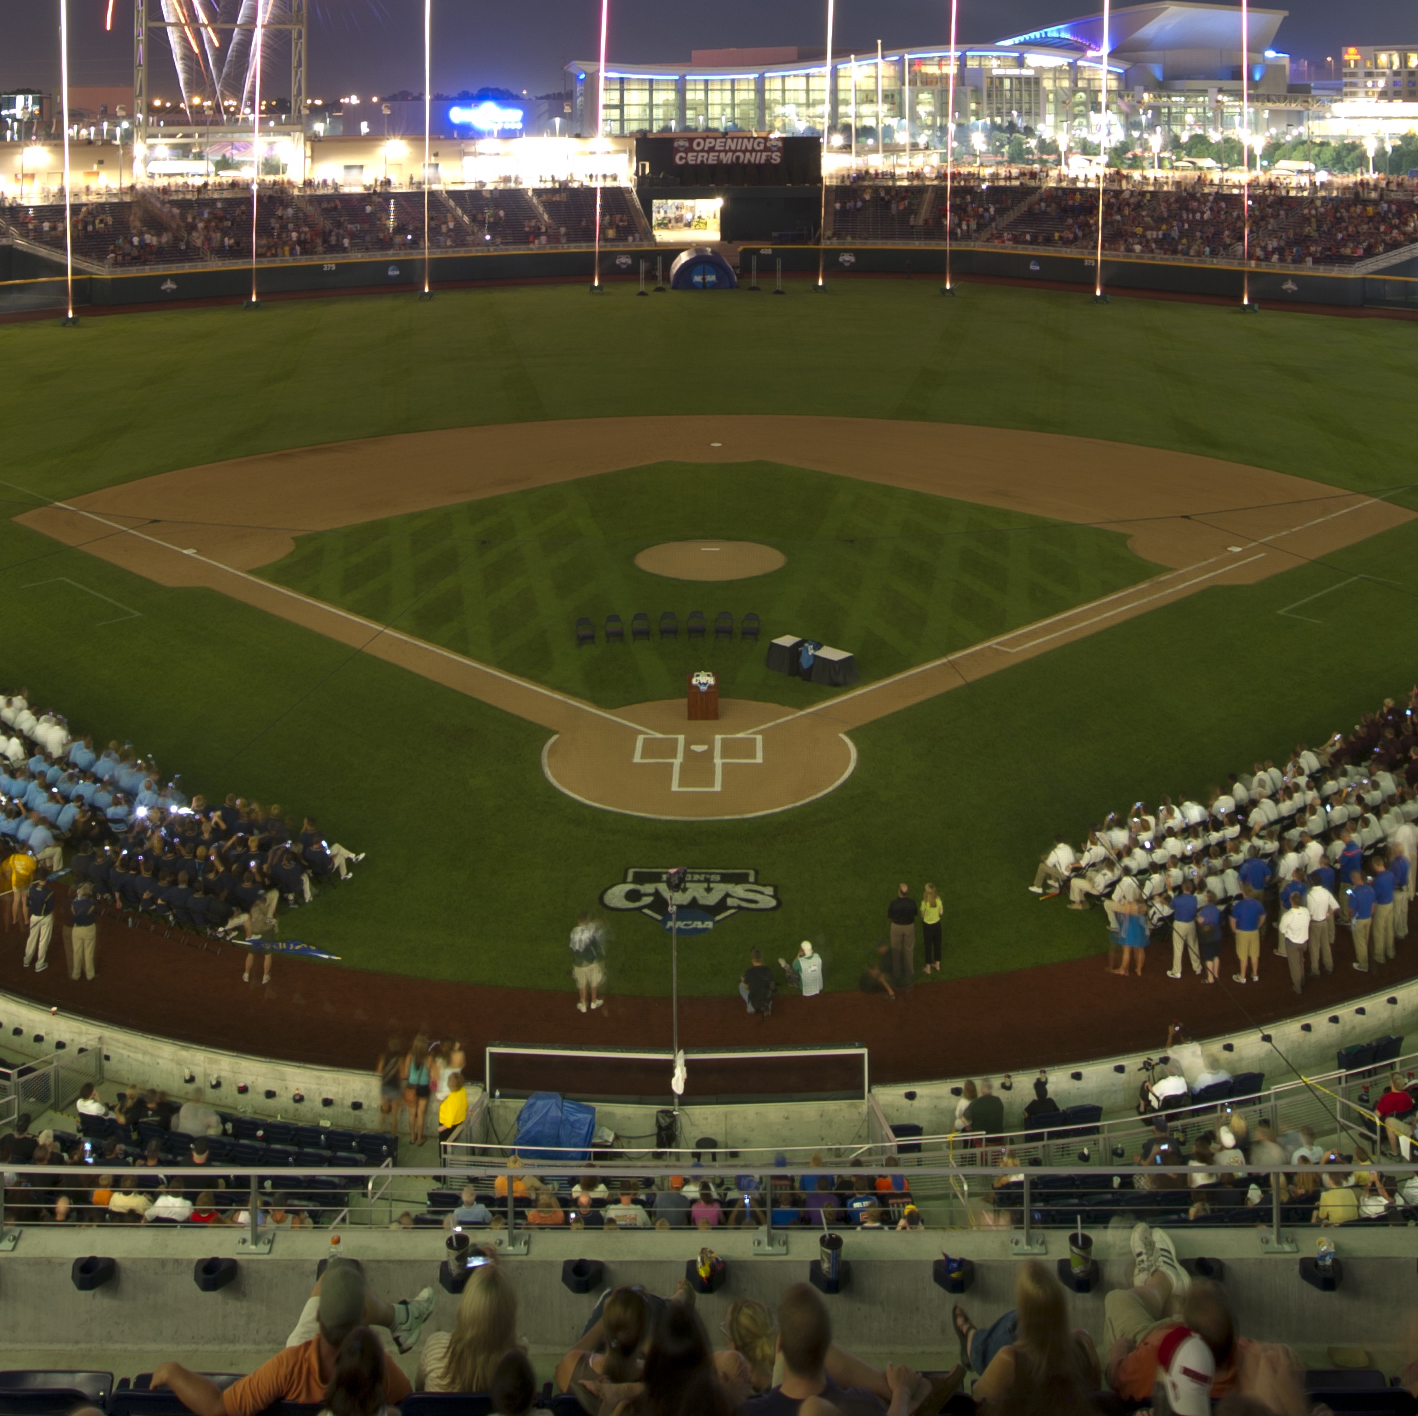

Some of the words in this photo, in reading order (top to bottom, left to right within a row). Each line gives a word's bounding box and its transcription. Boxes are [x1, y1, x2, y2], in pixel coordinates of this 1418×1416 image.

[692, 138, 765, 151] OPENING
[675, 152, 782, 165] CEREMONIES
[323, 263, 336, 271] 375
[1084, 259, 1096, 267] 375
[603, 883, 777, 909] CWS
[665, 921, 714, 929] NCAA
